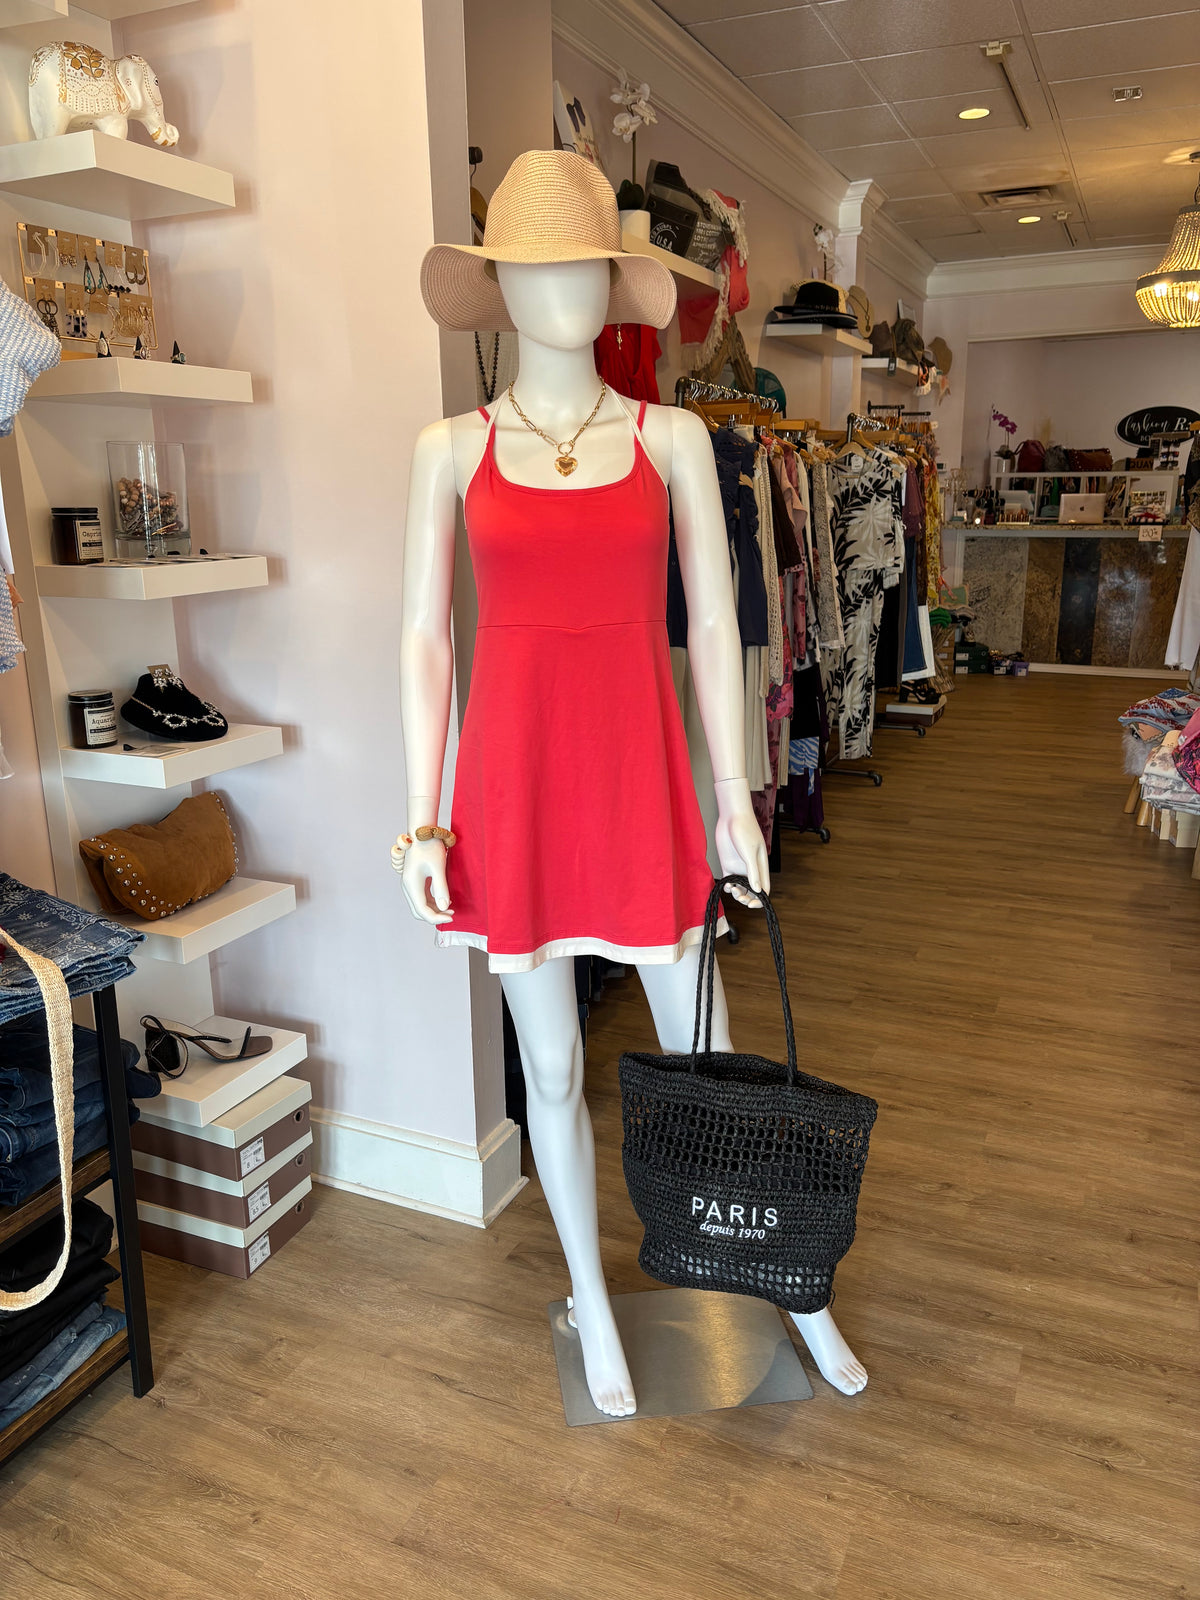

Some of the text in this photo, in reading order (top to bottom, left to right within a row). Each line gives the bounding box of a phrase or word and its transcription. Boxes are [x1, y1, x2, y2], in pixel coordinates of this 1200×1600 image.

[692, 1196, 778, 1227] PARIS
[699, 1220, 766, 1240] depuis 1970
